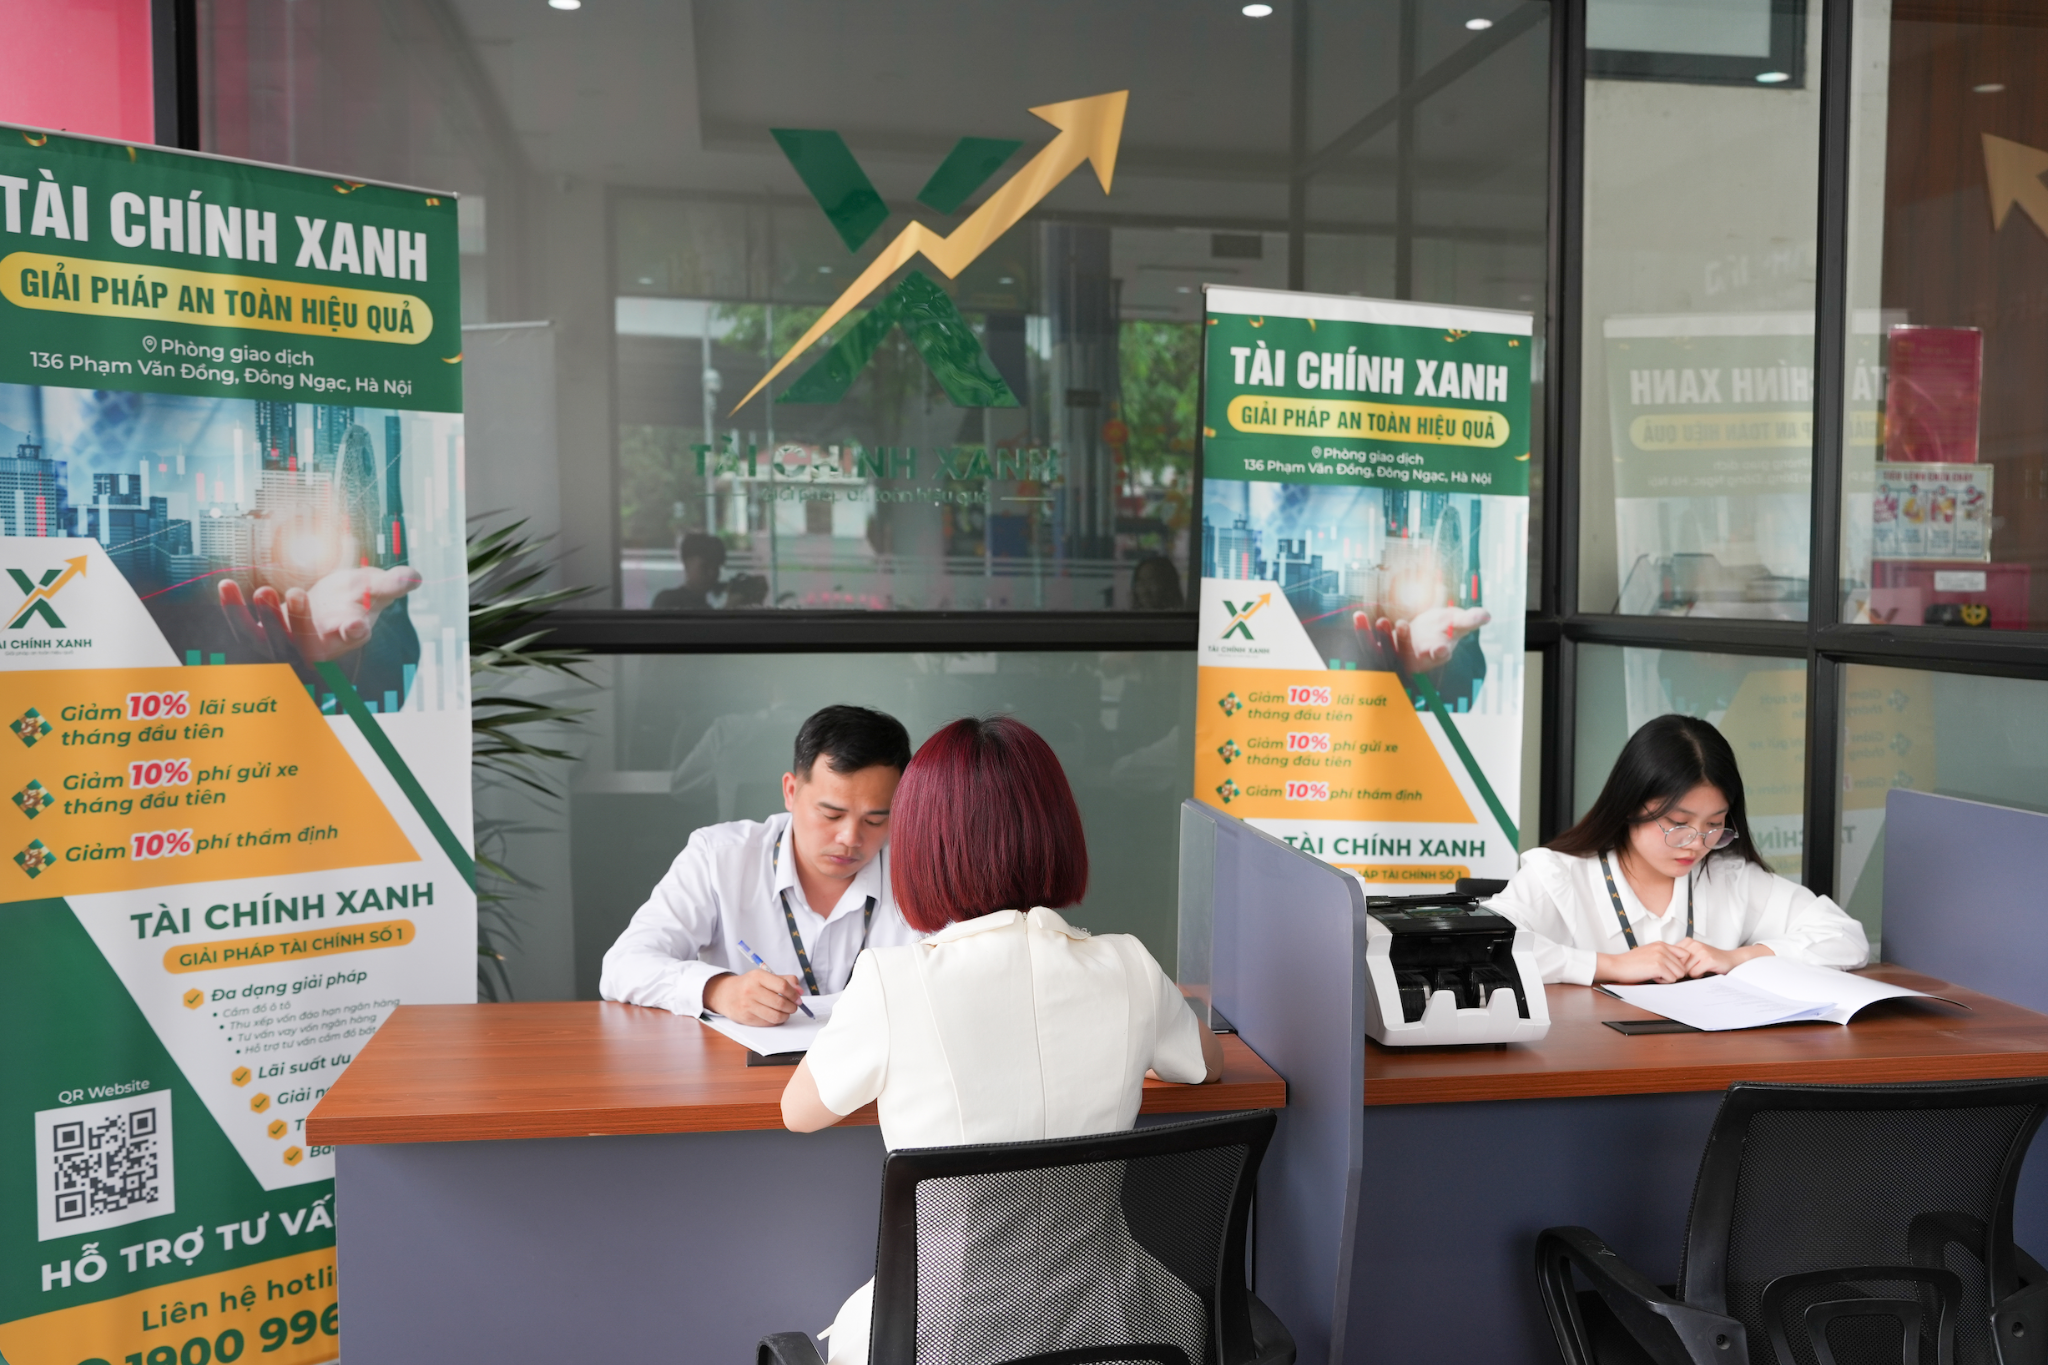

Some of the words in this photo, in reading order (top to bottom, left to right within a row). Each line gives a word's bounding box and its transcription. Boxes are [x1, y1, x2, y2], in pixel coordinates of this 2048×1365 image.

[0, 168, 88, 242] TÀI
[110, 190, 277, 264] CHÍNH
[295, 215, 427, 281] XANH
[20, 263, 80, 301] GIẢI
[91, 275, 168, 308] PHÁP
[178, 286, 214, 314] AN
[224, 287, 292, 322] TOÀN
[302, 296, 358, 332] HIỆU
[367, 300, 414, 334] QUẢ
[161, 339, 225, 362] Phòng
[229, 344, 270, 365] giao
[275, 349, 314, 367] dịch
[30, 351, 64, 369] 136
[70, 355, 132, 377] Phạm
[137, 359, 175, 378] Văn
[180, 363, 239, 386] Đồng,
[244, 368, 295, 389] Đông
[299, 373, 351, 393] Ngạc,
[355, 376, 379, 392] Hà
[384, 379, 412, 396] Nội
[1230, 340, 1286, 387] TÀI
[1297, 346, 1404, 395] CHÍNH
[1414, 359, 1508, 402] XANH
[1241, 400, 1277, 426] GIẢI
[1283, 407, 1330, 428] PHÁP
[1337, 413, 1362, 429] AN
[1367, 411, 1410, 434] TOÀN
[1417, 414, 1456, 440] HIỆU
[1462, 416, 1495, 439] QUẢ
[690, 435, 757, 477] TÀI
[773, 436, 916, 479] CHÍNH
[932, 447, 1059, 481] XANH
[1324, 448, 1366, 462] Phòng
[1369, 451, 1394, 464] giao
[1396, 452, 1424, 466] dịch
[1244, 459, 1265, 471] 136
[1267, 460, 1305, 475] Phạm
[1308, 462, 1333, 474] Văn
[1336, 463, 1374, 479] Đồng,
[1377, 466, 1409, 481] Đông
[1413, 469, 1449, 483] Ngạc,
[1451, 471, 1468, 482] Hà
[1471, 473, 1492, 485] Nội
[11, 637, 51, 649] CHÍNH
[56, 639, 92, 648] XANH
[60, 702, 122, 721] Giảm
[129, 693, 187, 717] 10%
[199, 699, 225, 715] lãi
[232, 695, 278, 714] suất
[1249, 692, 1285, 703] Giảm
[1290, 689, 1329, 703] 10%
[1337, 695, 1354, 705] lãi
[1358, 694, 1387, 707] suất
[62, 728, 131, 747] tháng
[138, 724, 177, 742] đầu
[184, 723, 224, 741] tiên
[1247, 738, 1283, 749] Giảm
[1289, 735, 1327, 749] 10%
[1333, 740, 1355, 752] phí
[1360, 739, 1381, 754] gửi
[62, 772, 124, 790] Giảm
[131, 761, 189, 786] 10%
[197, 765, 232, 785] phí
[237, 763, 271, 782] gửi
[276, 764, 299, 777] xe
[64, 796, 133, 815] tháng
[140, 791, 179, 809] đầu
[186, 789, 226, 806] tiên
[65, 842, 126, 861] Giảm
[133, 831, 191, 857] 10%
[196, 833, 230, 854] phí
[236, 827, 291, 846] thẩm
[297, 825, 338, 844] định
[1334, 833, 1411, 855] CHÍNH
[1419, 839, 1485, 858] XANH
[1382, 869, 1399, 879] TÀI
[1402, 869, 1436, 879] CHÍNH
[1440, 867, 1454, 879] SỐ
[130, 904, 191, 939] TÀI
[205, 893, 324, 930] CHÍNH
[336, 882, 434, 916] XANH
[179, 948, 218, 966] GIẢI
[224, 942, 275, 962] PHÁP
[280, 939, 307, 956] TÀI
[312, 931, 365, 951] CHÍNH
[370, 925, 393, 944] SỐ
[396, 928, 403, 940] 1
[212, 990, 236, 1002] Đa
[242, 984, 287, 999] dạng
[292, 975, 323, 994] giải
[326, 970, 367, 989] pháp
[258, 1062, 285, 1078] Lãi
[290, 1055, 326, 1074] suất
[331, 1054, 351, 1066] ưu
[58, 1089, 84, 1104] QR
[88, 1079, 150, 1099] Website
[278, 1087, 311, 1105] Giải
[42, 1242, 108, 1292] HỖ
[120, 1226, 204, 1273] TRỢ
[215, 1211, 270, 1250] TƯ
[279, 1194, 335, 1236] VẤ
[142, 1301, 208, 1331] Liên
[220, 1285, 256, 1312] hệ
[268, 1265, 337, 1300] hotli
